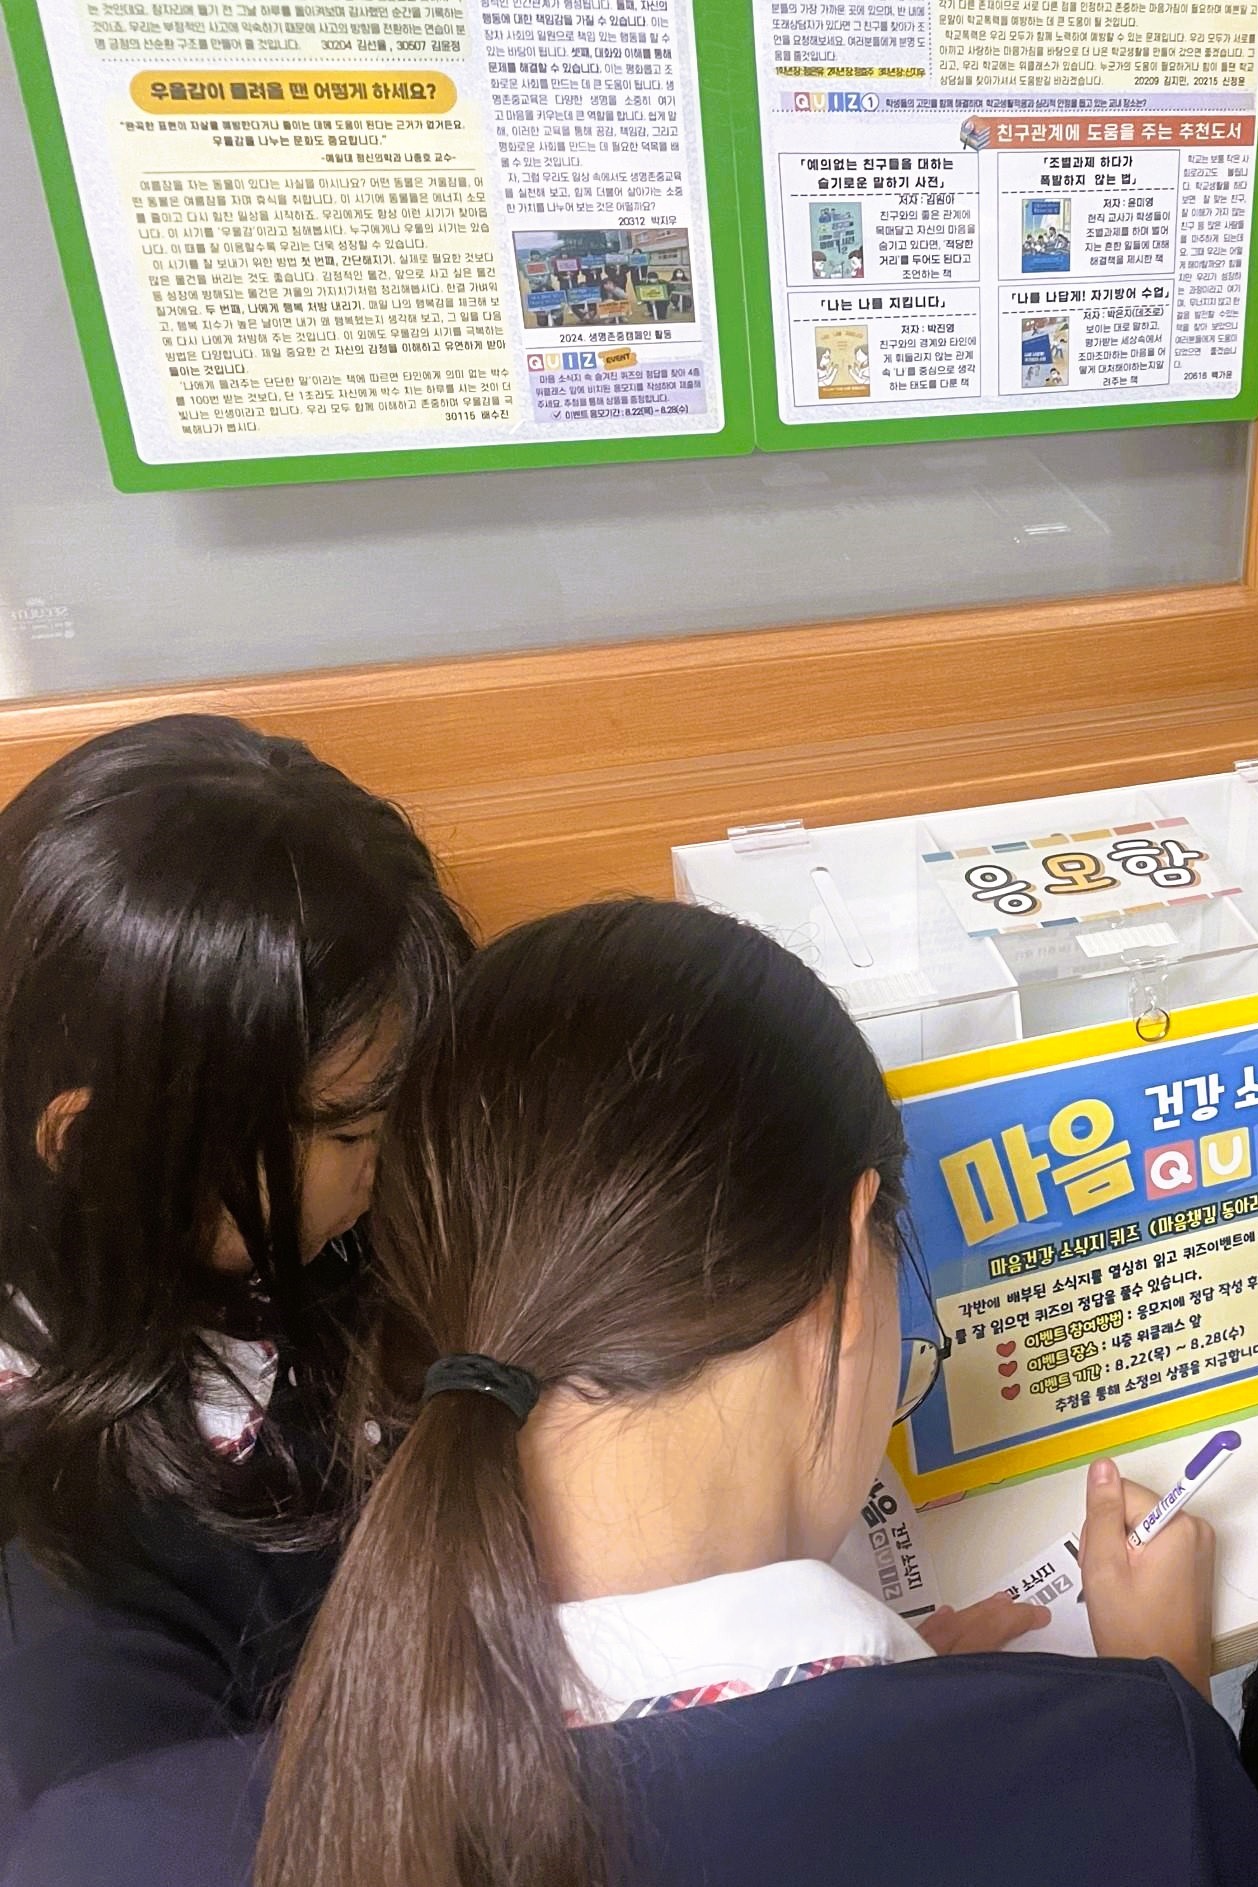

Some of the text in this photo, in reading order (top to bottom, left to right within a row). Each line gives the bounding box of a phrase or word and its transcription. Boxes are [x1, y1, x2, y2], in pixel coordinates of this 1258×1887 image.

[314, 82, 368, 100] 어떻게
[372, 82, 436, 100] 하세요?
[795, 93, 860, 111] QUIZ
[997, 122, 1241, 142] 친구관계에 도움을 주는 추천도서
[863, 158, 912, 170] 친구들을
[918, 158, 954, 170] 대하는
[1101, 156, 1133, 167] 하다가
[818, 177, 867, 189] 슬기로운
[873, 177, 909, 188] 말하기
[1041, 174, 1085, 186] 폭발하지
[1095, 174, 1116, 185] 않는
[899, 195, 918, 205] 저자
[859, 298, 882, 310] 나를
[1046, 290, 1085, 302] 나답게!
[1091, 288, 1136, 301] 자기방어
[248, 303, 279, 313] 나에게
[560, 334, 585, 342] 2024.
[901, 325, 919, 334] 저자
[528, 353, 595, 371] QUIZ
[606, 353, 630, 364] EVENT
[965, 838, 1208, 915] 응모함
[1145, 1073, 1225, 1131] 건강
[939, 1098, 1135, 1247] 마음
[990, 1247, 1055, 1278] 마음건강
[1060, 1234, 1105, 1260] 소식지
[1109, 1225, 1142, 1248] 퀴즈
[1149, 1206, 1217, 1237] (마음챙김
[959, 1296, 1000, 1317] 각반에
[1007, 1282, 1047, 1304] 배부된
[1052, 1268, 1102, 1294] 소식지를
[1108, 1259, 1147, 1279] 열심히
[1153, 1250, 1177, 1269] 읽고
[1183, 1230, 1255, 1260] 퀴즈이벤트에
[972, 1321, 985, 1340] 잘
[991, 1312, 1030, 1335] 읽으면
[1034, 1301, 1073, 1322] 퀴즈의
[1078, 1289, 1116, 1311] 정답을
[1120, 1281, 1143, 1301] 풀수
[1148, 1271, 1202, 1294] 있습니다.
[1024, 1326, 1068, 1348] 이벤트
[1068, 1310, 1124, 1339] 참여방법
[1137, 1296, 1185, 1321] 응모지에
[1189, 1286, 1214, 1305] 정답
[1218, 1280, 1243, 1298] 작성
[1248, 1276, 1257, 1289] 후
[1027, 1349, 1069, 1371] 이벤트
[1070, 1342, 1099, 1361] 장소
[1137, 1318, 1185, 1342] 위클래스
[1189, 1314, 1202, 1330] 앞
[1030, 1374, 1071, 1395] 이벤트
[1073, 1364, 1102, 1382] 기간
[1115, 1346, 1171, 1371] 8.22(목)
[1190, 1325, 1245, 1350] 8.28(수)
[1055, 1390, 1091, 1412] 추첨을
[1096, 1383, 1120, 1400] 통해
[1125, 1371, 1162, 1392] 소정의
[1166, 1361, 1200, 1381] 상품을
[1143, 1481, 1186, 1531] paul frank
[891, 1522, 923, 1589] 건강 소식지
[1022, 1562, 1055, 1592] 소식지
